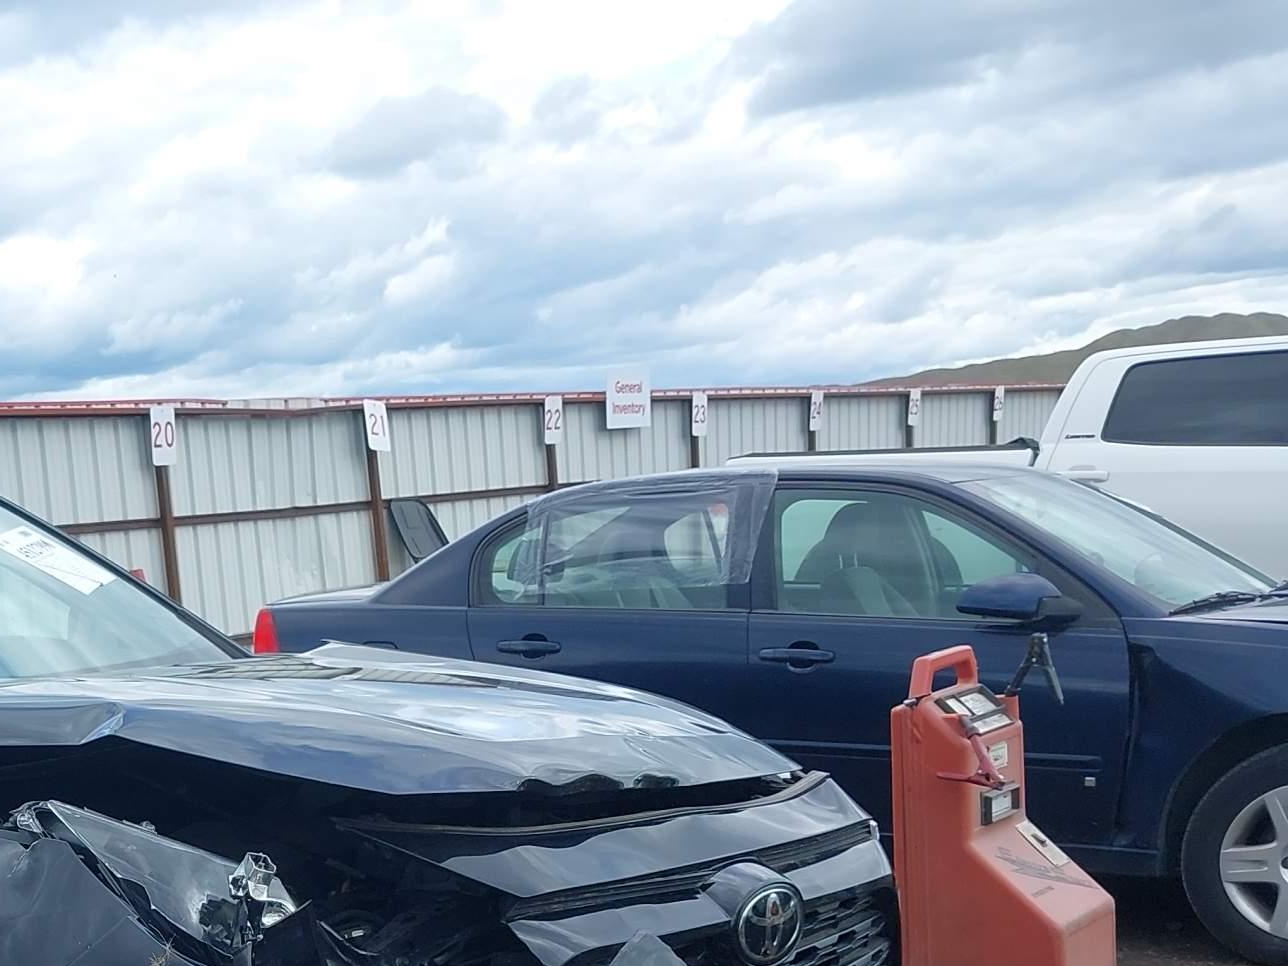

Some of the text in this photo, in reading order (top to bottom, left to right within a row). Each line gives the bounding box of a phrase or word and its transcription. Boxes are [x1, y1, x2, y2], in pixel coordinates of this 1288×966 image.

[615, 380, 643, 394] General
[612, 401, 646, 417] Inventory
[693, 404, 706, 424] 23
[811, 401, 822, 420] 24
[369, 413, 386, 437] 21
[546, 409, 561, 430] 22
[152, 421, 175, 448] 20
